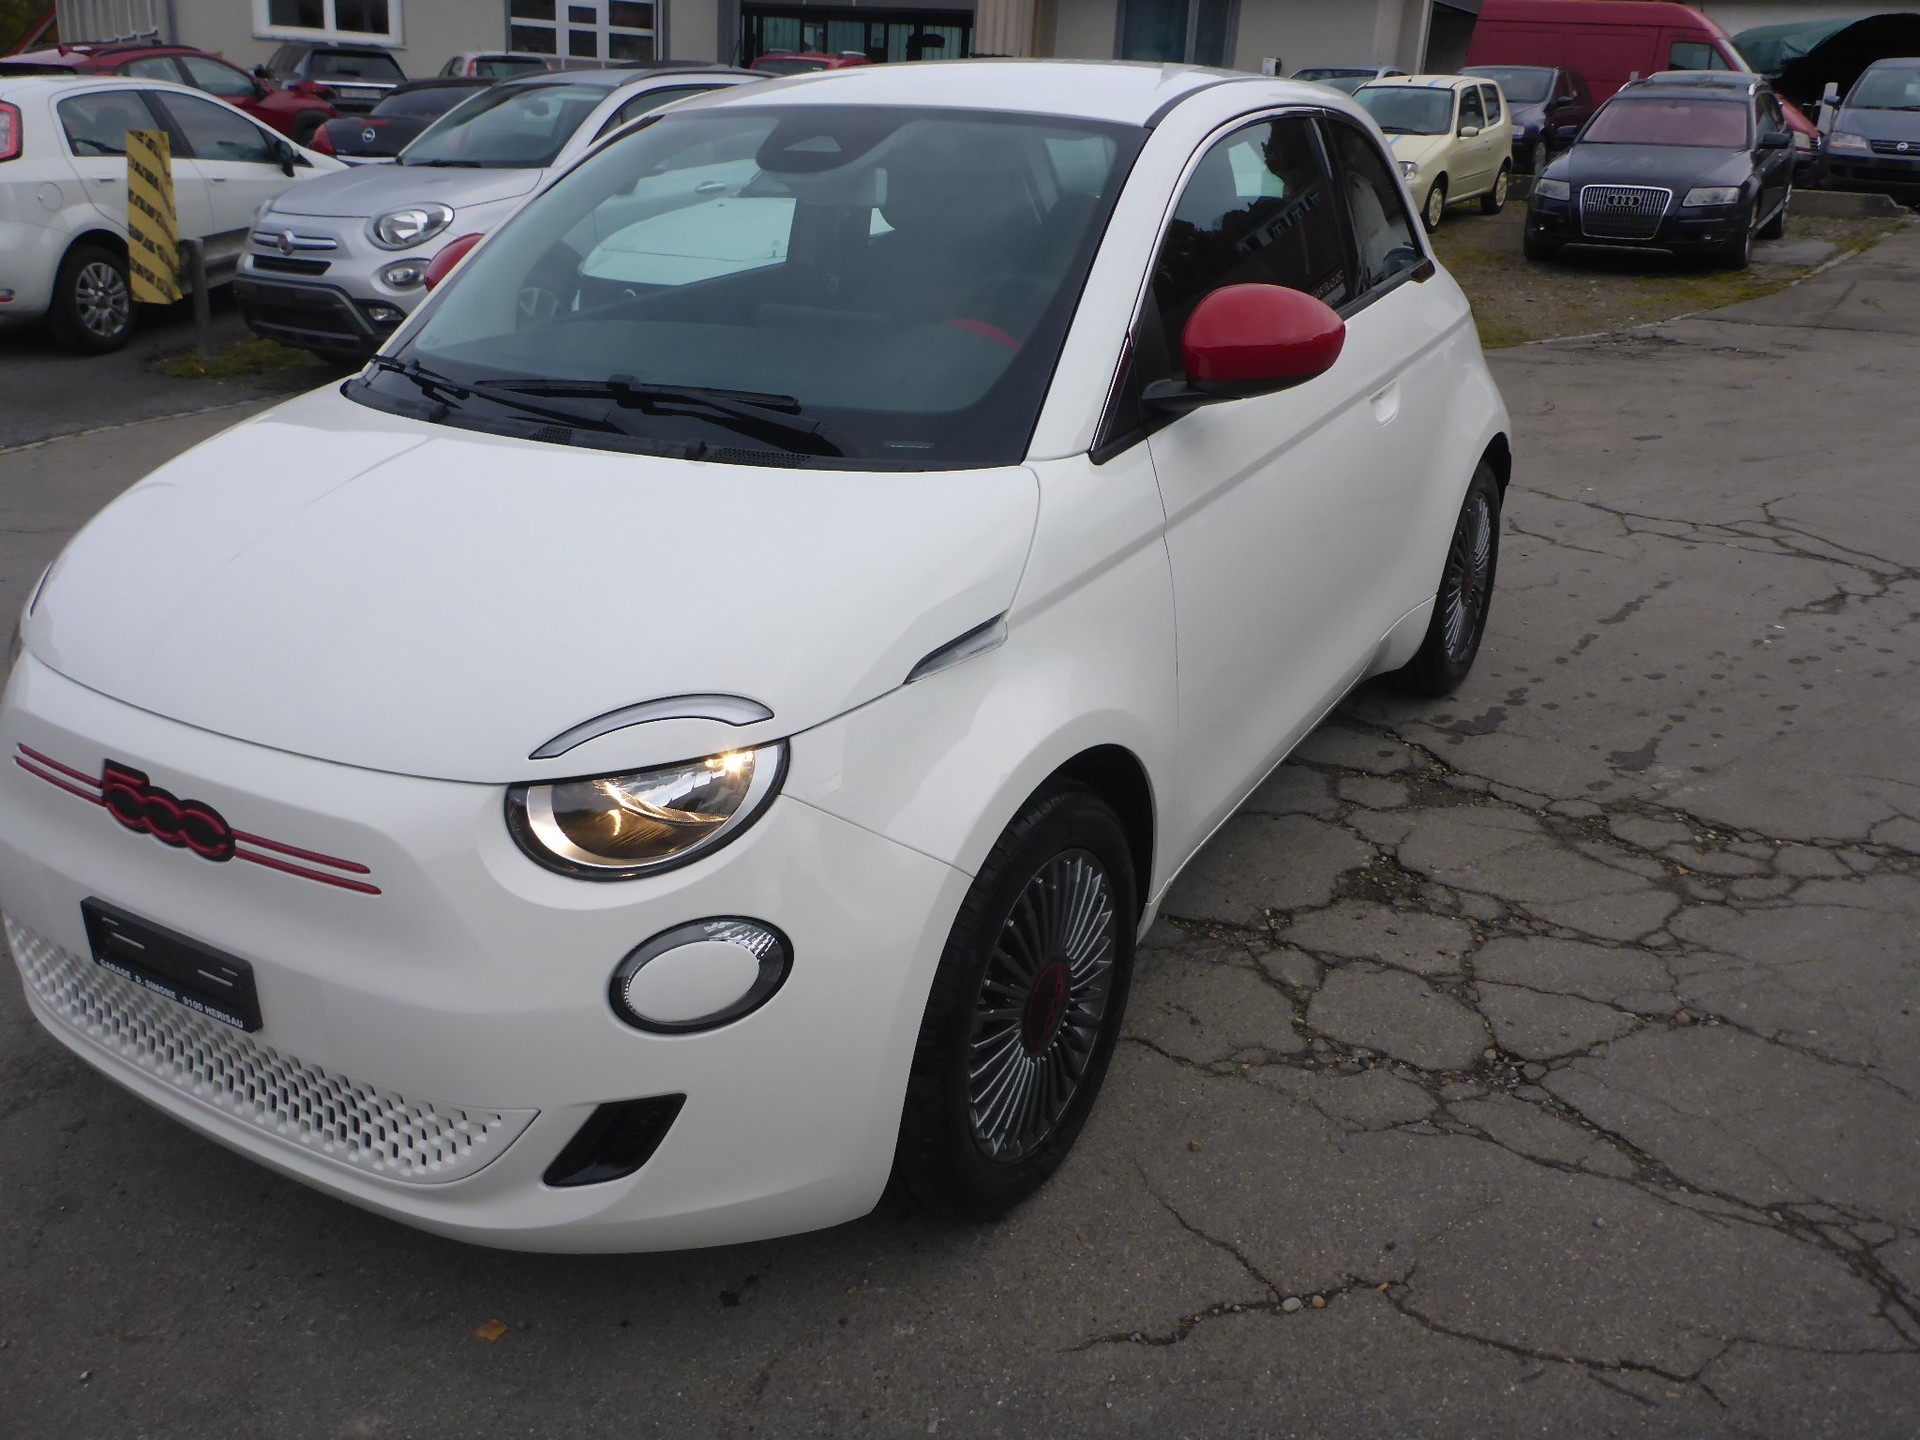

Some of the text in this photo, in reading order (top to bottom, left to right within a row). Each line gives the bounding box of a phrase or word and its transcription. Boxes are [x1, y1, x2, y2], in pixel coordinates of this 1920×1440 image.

[99, 958, 132, 981] GARAGE
[145, 979, 178, 1001] SIMONE
[183, 995, 204, 1012] 9100
[205, 1004, 244, 1029] HERISAU
